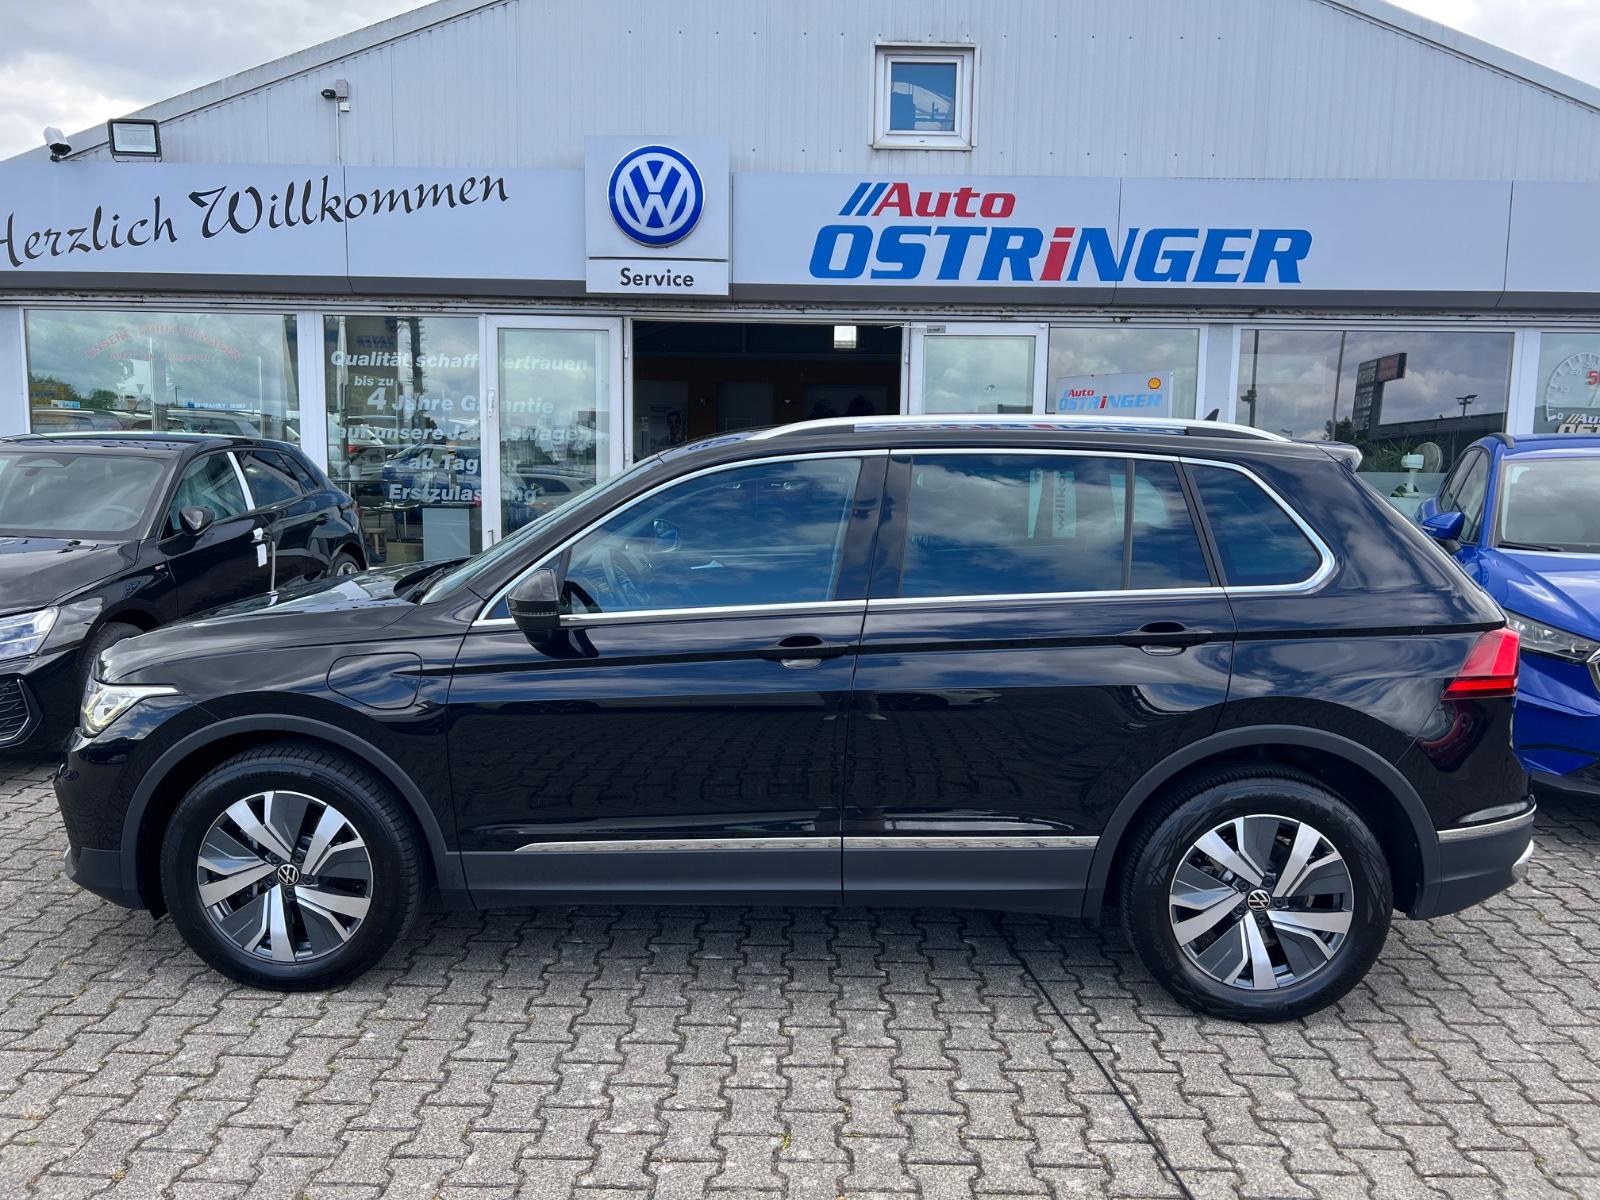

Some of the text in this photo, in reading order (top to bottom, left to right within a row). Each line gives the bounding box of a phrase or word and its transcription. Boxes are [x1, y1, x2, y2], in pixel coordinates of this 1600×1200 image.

[188, 174, 510, 239] Willkommen
[871, 182, 1016, 218] Auto
[620, 267, 694, 287] Service
[416, 352, 480, 369] schaff
[503, 355, 588, 370] ertrauen
[354, 375, 394, 387] bis zu
[1587, 371, 1600, 386] 5
[367, 387, 387, 410] 4
[392, 394, 454, 411] Jahre
[1068, 389, 1095, 398] Auto
[409, 455, 478, 475] ab Tag
